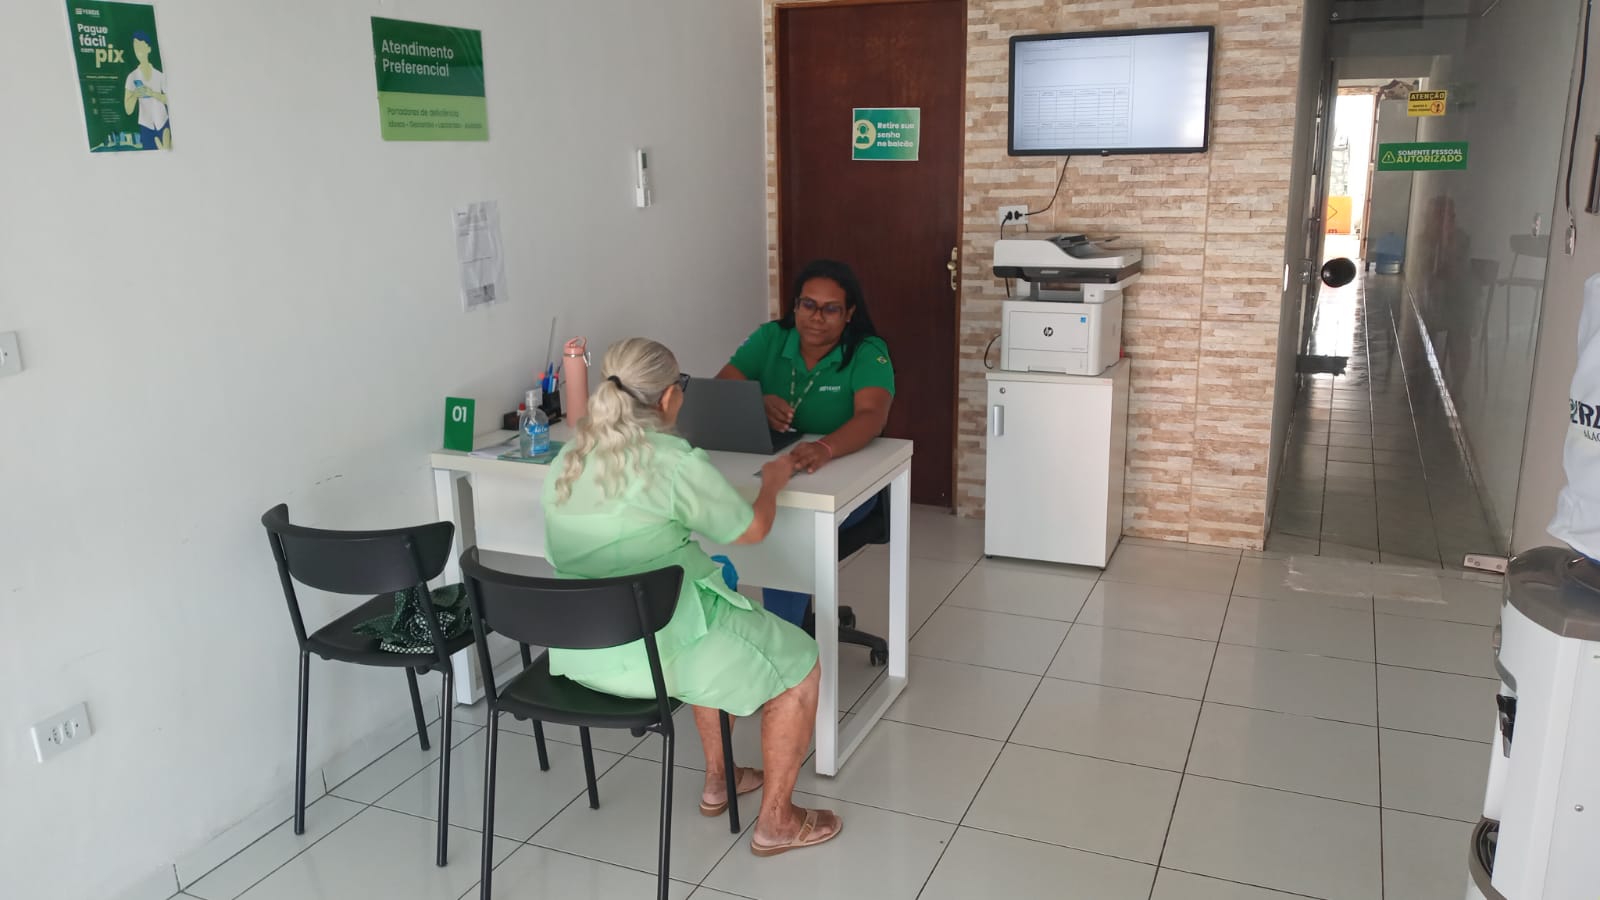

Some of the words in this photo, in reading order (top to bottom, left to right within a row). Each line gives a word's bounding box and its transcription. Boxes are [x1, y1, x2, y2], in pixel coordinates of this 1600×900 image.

[77, 23, 108, 36] Pague
[79, 33, 106, 47] fácil
[95, 43, 125, 68] pix
[381, 39, 454, 59] Atendimento
[382, 58, 449, 77] Preferencial
[1411, 92, 1445, 100] ATENÇÃO
[877, 121, 900, 129] Retire
[1396, 154, 1463, 164] AUTORIZADO
[452, 405, 467, 423] 01
